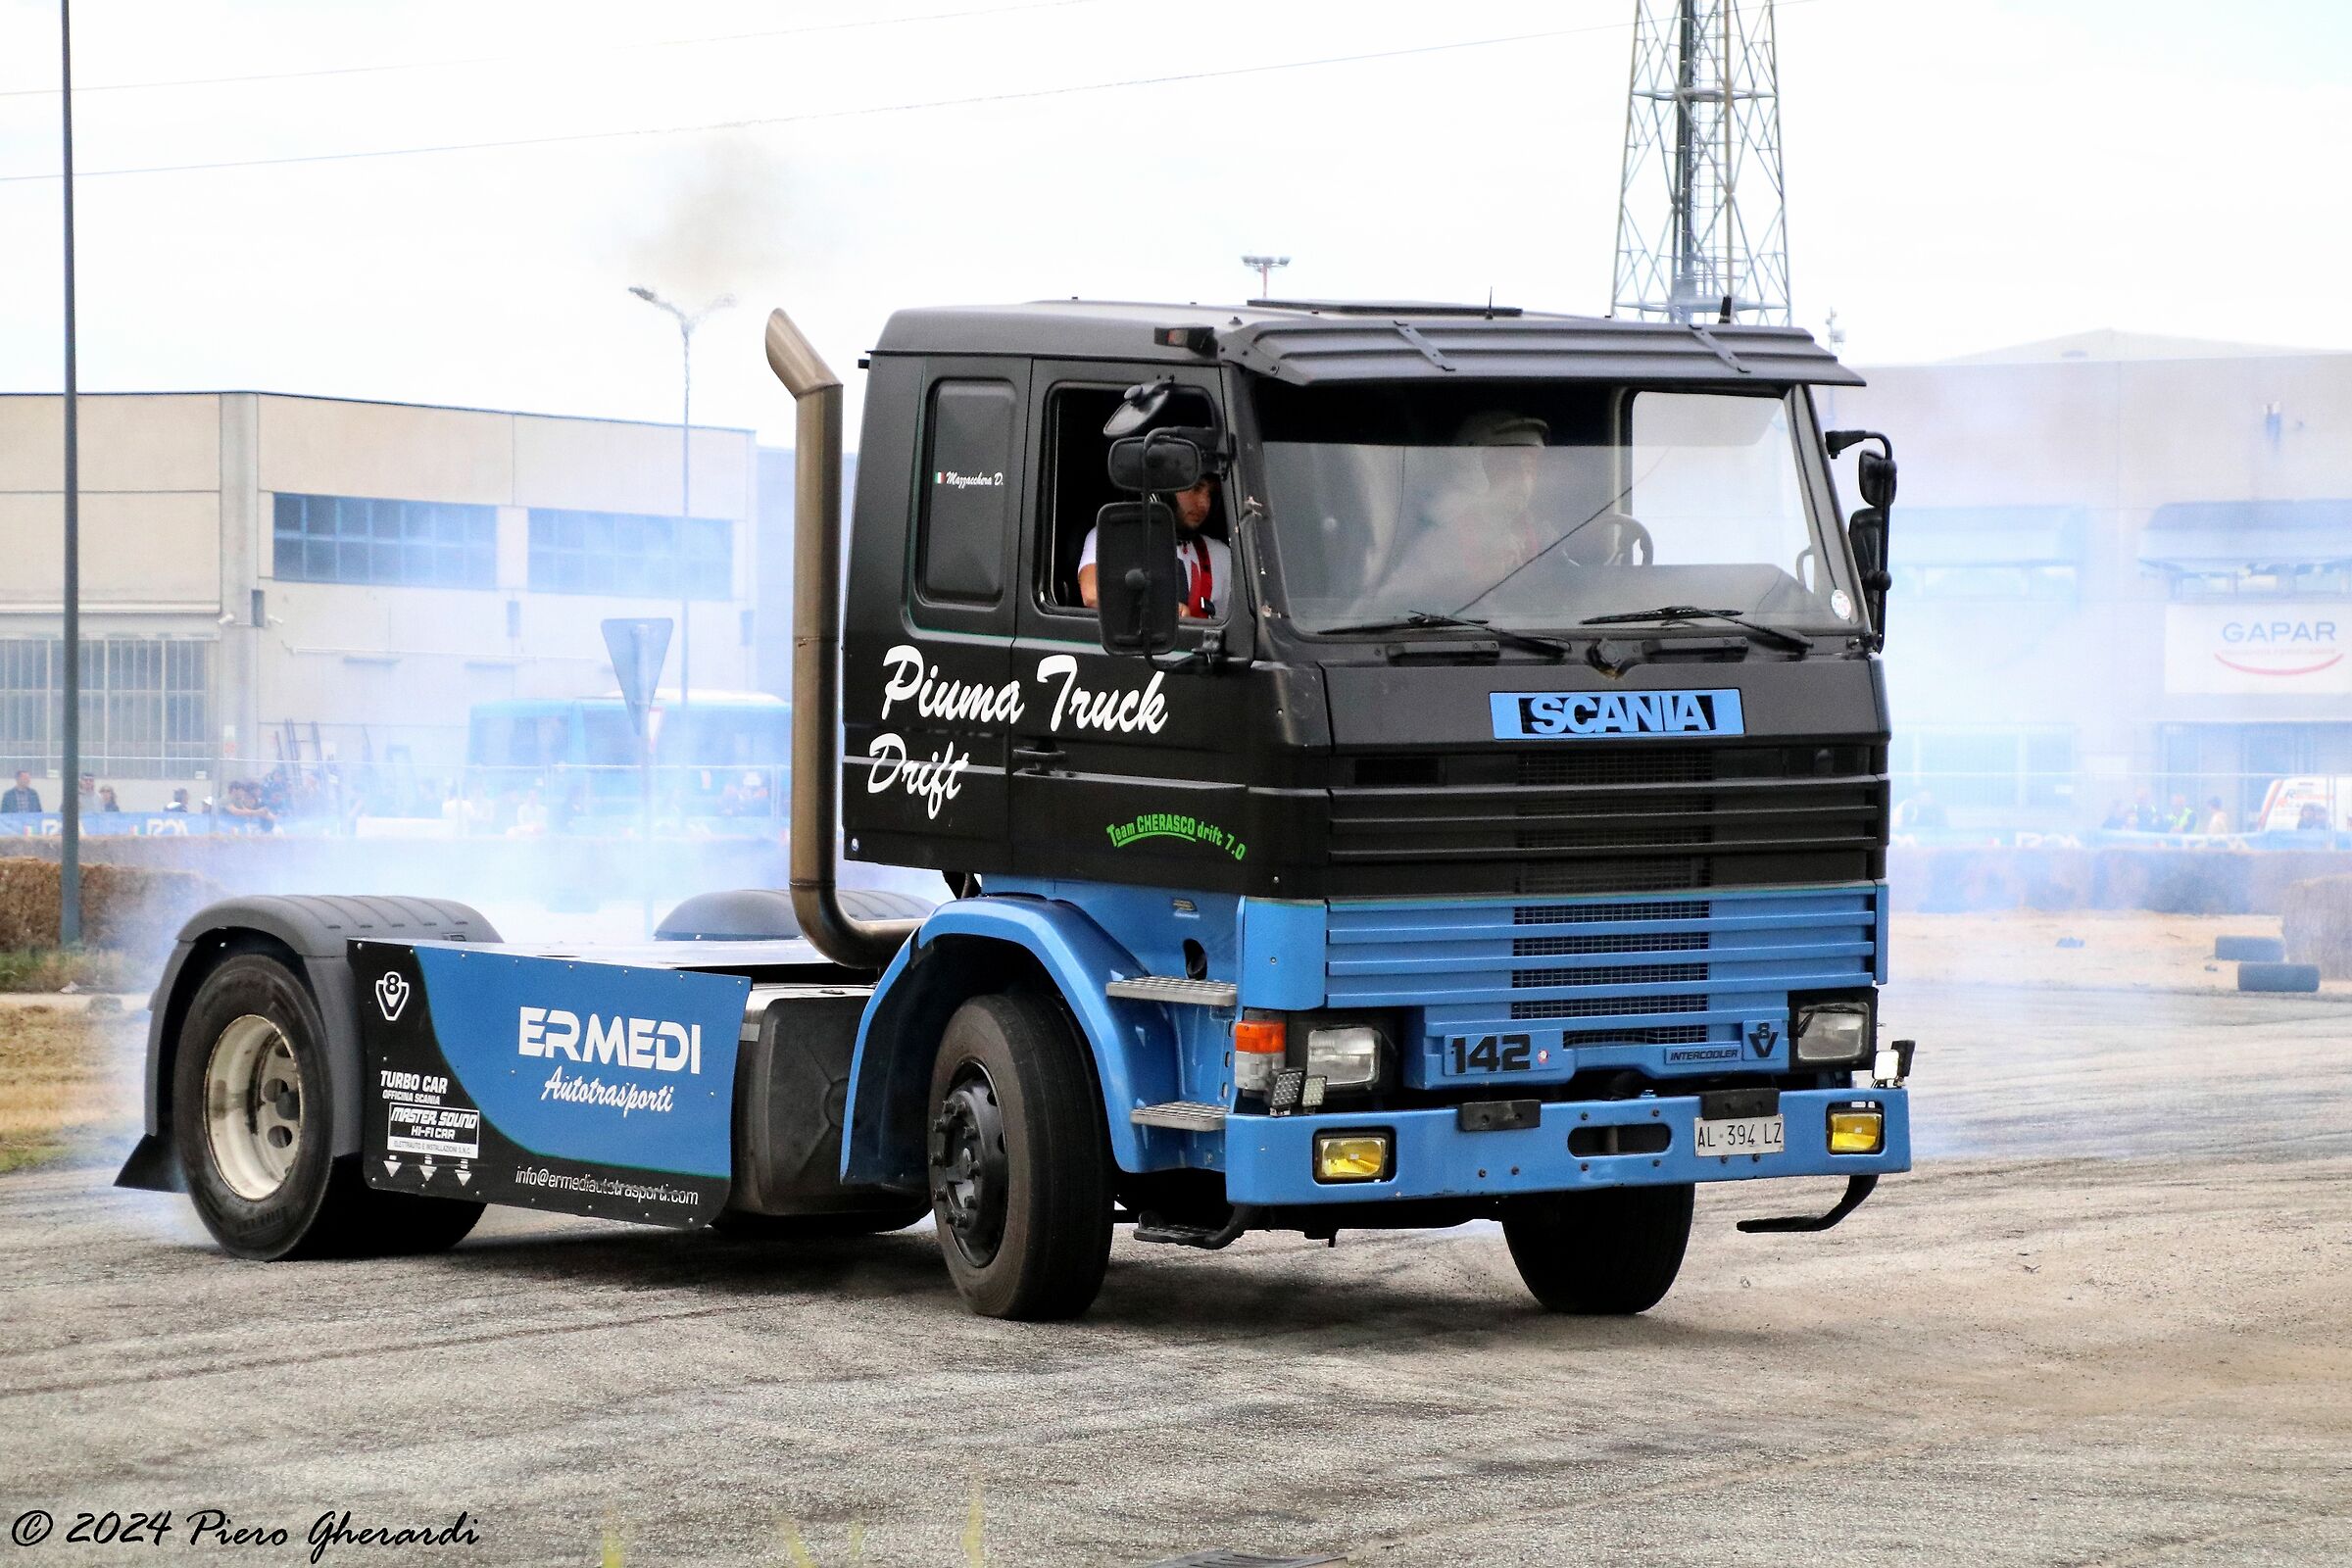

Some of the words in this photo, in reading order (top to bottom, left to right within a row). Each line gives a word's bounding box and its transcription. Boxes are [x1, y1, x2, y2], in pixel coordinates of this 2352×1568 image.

[994, 471, 1004, 485] D.
[2222, 621, 2336, 643] GAPAR
[881, 644, 1025, 724] Piuma
[1036, 654, 1169, 734] Truck
[1529, 692, 1712, 734] SCANIA
[867, 732, 969, 820] Drift
[1106, 822, 1136, 847] Team
[1137, 813, 1196, 834] CHERASCO
[1197, 821, 1223, 846] drift
[1225, 833, 1247, 860] 7.0
[518, 1005, 701, 1075] ERMEDI
[1449, 1033, 1532, 1074] 142
[1670, 1049, 1738, 1060] INTERCOOLER
[380, 1070, 420, 1091] TURBO
[422, 1075, 448, 1095] CAR
[382, 1089, 414, 1102] OFFICINA
[414, 1093, 441, 1105] SCANIA
[540, 1065, 674, 1118] Autotrasporti
[391, 1106, 438, 1126] MASTER
[438, 1111, 478, 1129] SOUND
[411, 1125, 434, 1138] HI-FI
[434, 1127, 456, 1140] CAR
[1697, 1126, 1716, 1148] AL
[1727, 1124, 1755, 1146] 394
[1764, 1122, 1782, 1145] LZ
[514, 1165, 699, 1205] info@ermediautotrasporti.com
